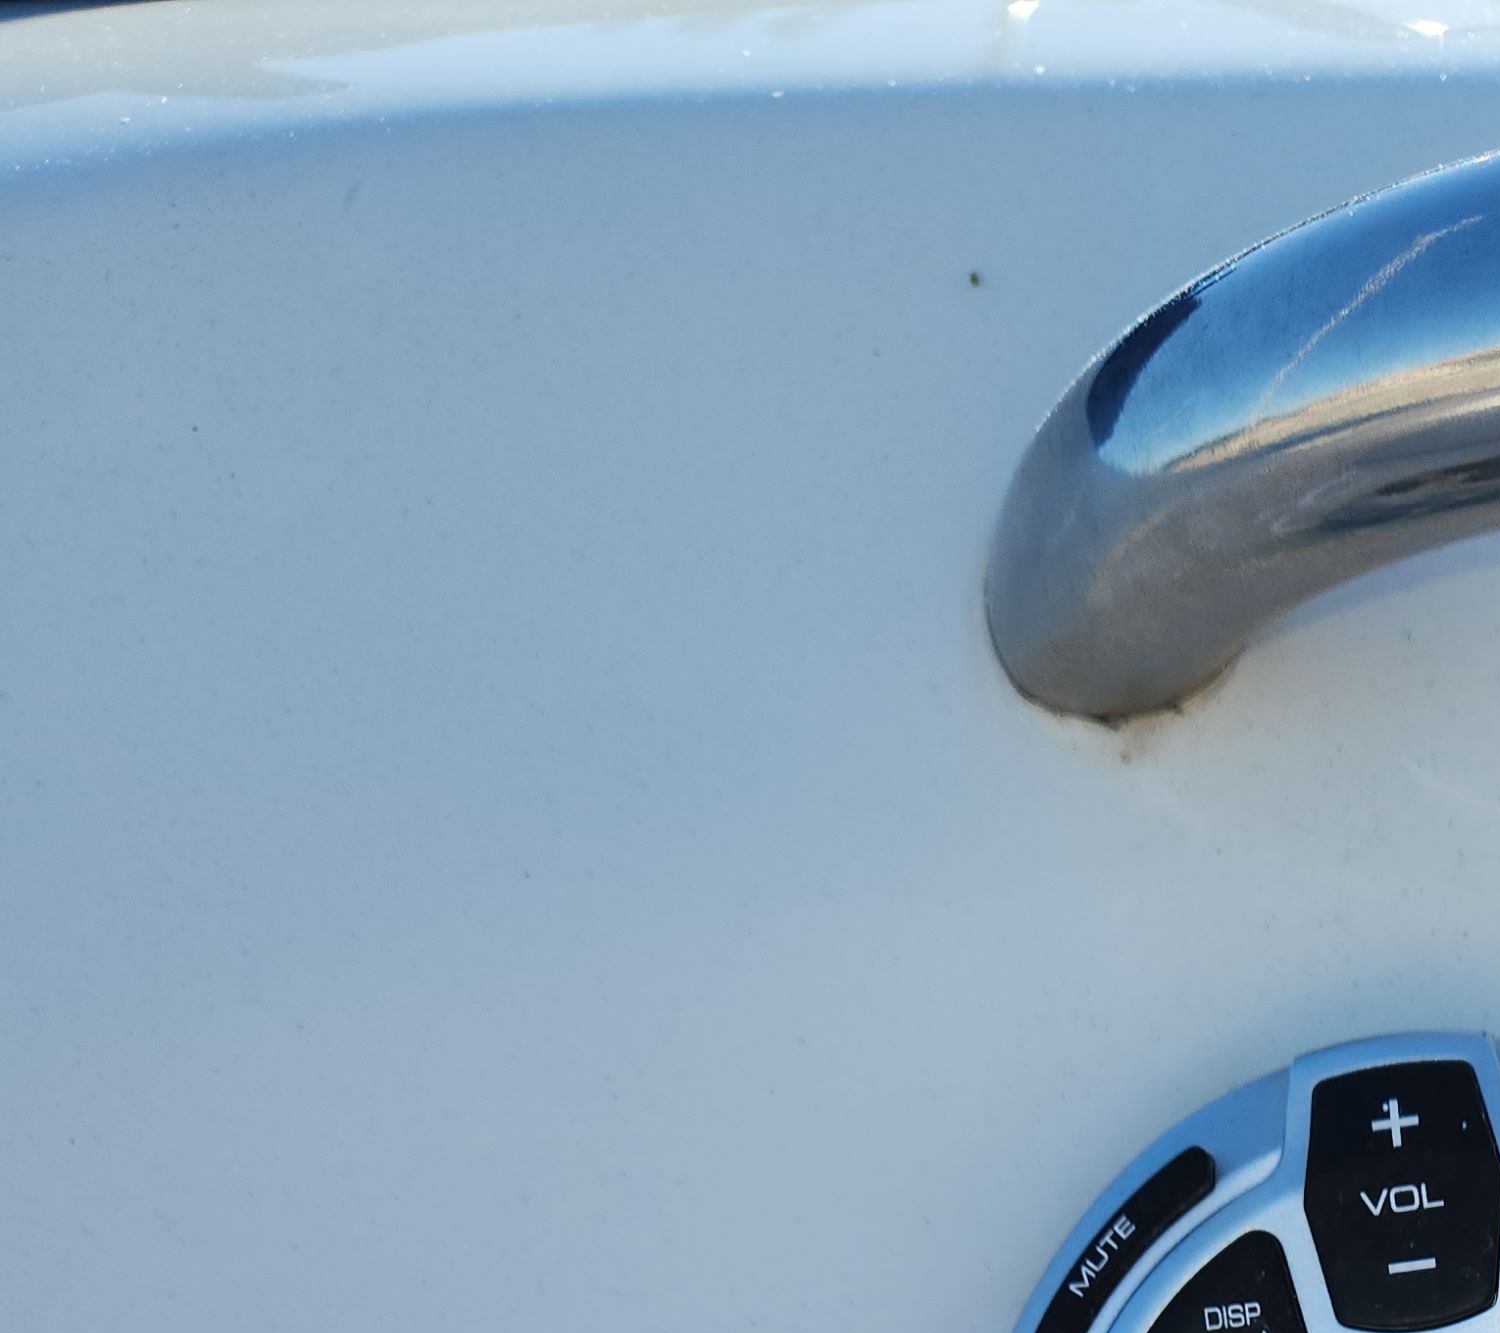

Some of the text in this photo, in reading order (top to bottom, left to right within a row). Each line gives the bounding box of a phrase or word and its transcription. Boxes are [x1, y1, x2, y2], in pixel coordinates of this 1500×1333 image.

[1360, 1183, 1445, 1216] VOL
[1069, 1214, 1136, 1298] MUTE
[1203, 1302, 1261, 1331] DISP
